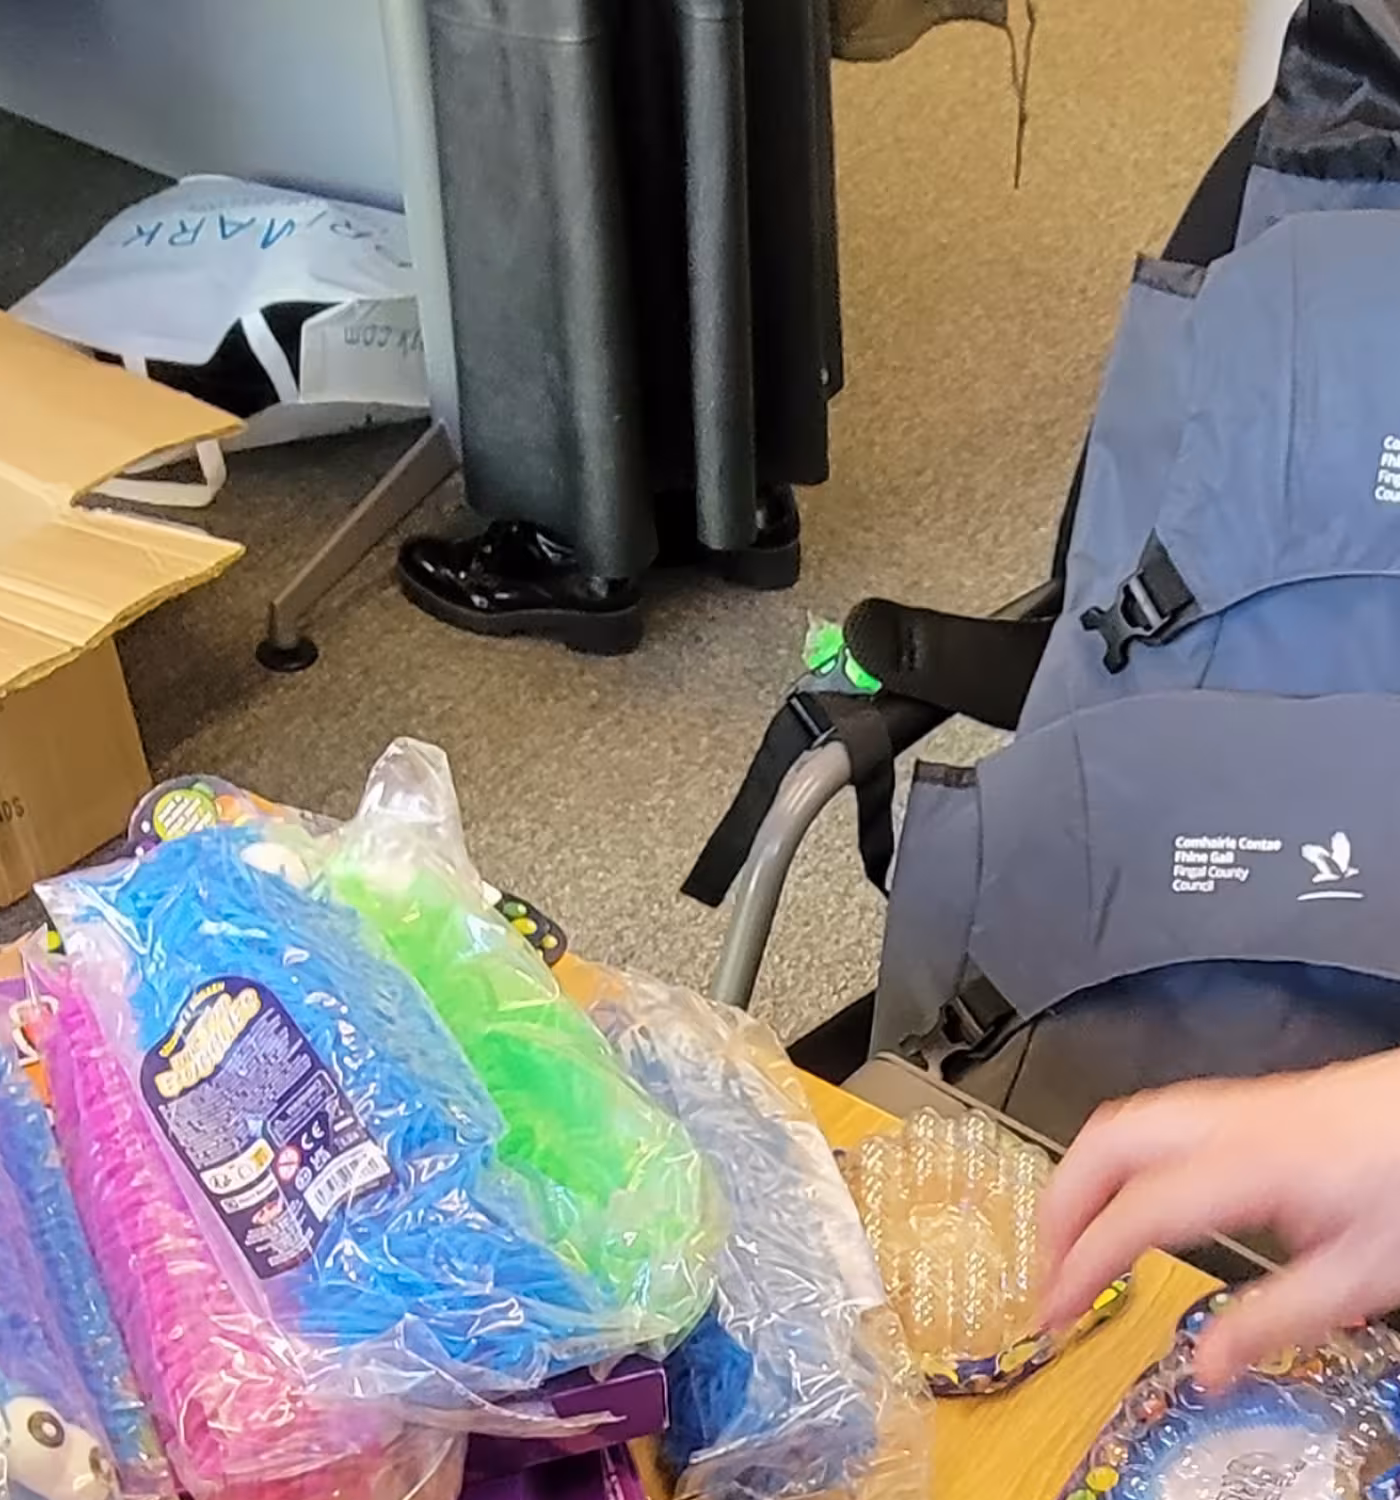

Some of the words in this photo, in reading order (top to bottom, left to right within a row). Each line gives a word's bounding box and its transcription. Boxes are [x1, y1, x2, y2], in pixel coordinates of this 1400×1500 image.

[1175, 836, 1236, 850] Comhairle
[1238, 837, 1282, 851] Contae
[1174, 850, 1208, 863] Fhine
[1210, 851, 1234, 864] Gall
[1173, 865, 1207, 879] Fingal
[1208, 866, 1249, 882] County
[1172, 879, 1215, 892] Council
